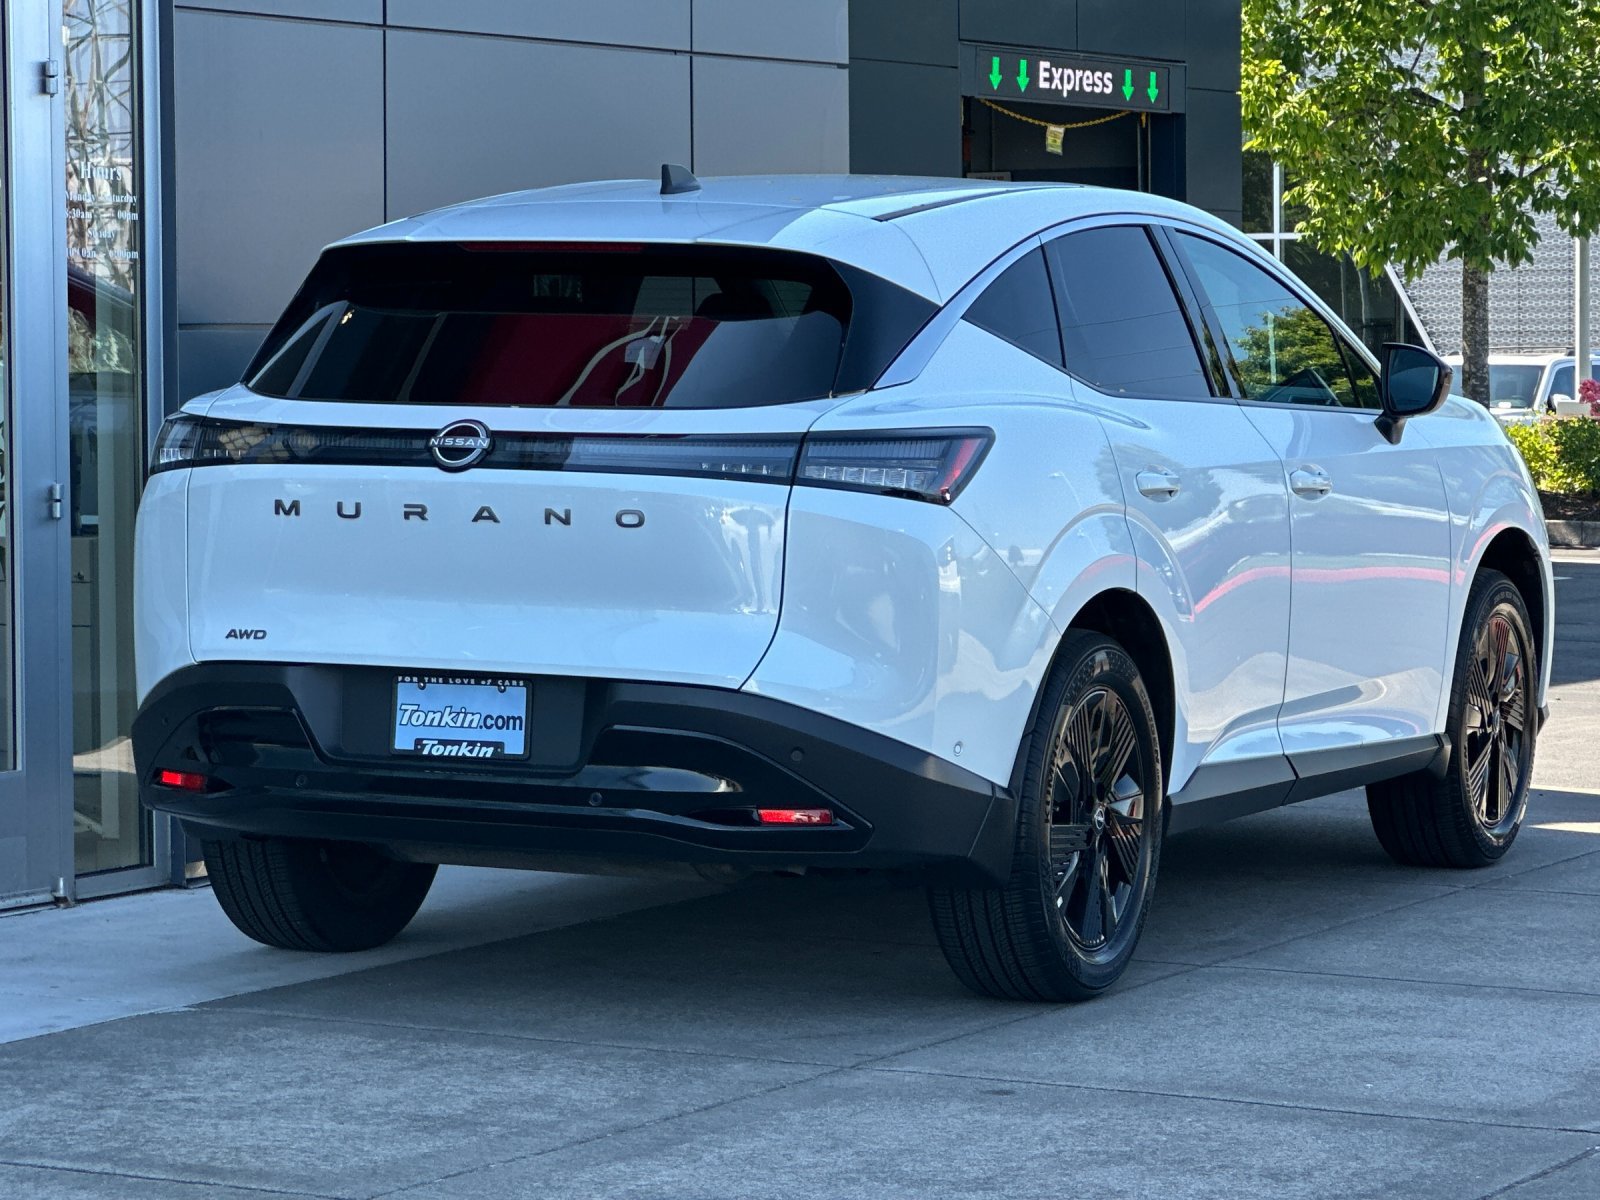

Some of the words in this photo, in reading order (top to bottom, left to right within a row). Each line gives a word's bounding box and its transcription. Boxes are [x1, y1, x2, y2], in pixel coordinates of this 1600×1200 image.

[1039, 60, 1113, 98] Express
[429, 437, 489, 448] NISSAN
[274, 499, 646, 529] MURANO
[225, 628, 268, 640] AWD
[397, 675, 419, 683] FOR
[424, 676, 444, 684] THE
[449, 677, 476, 685] LOVE
[497, 679, 525, 687] CARS
[399, 703, 524, 731] Tonkin.com
[422, 740, 495, 758] Tonkin
